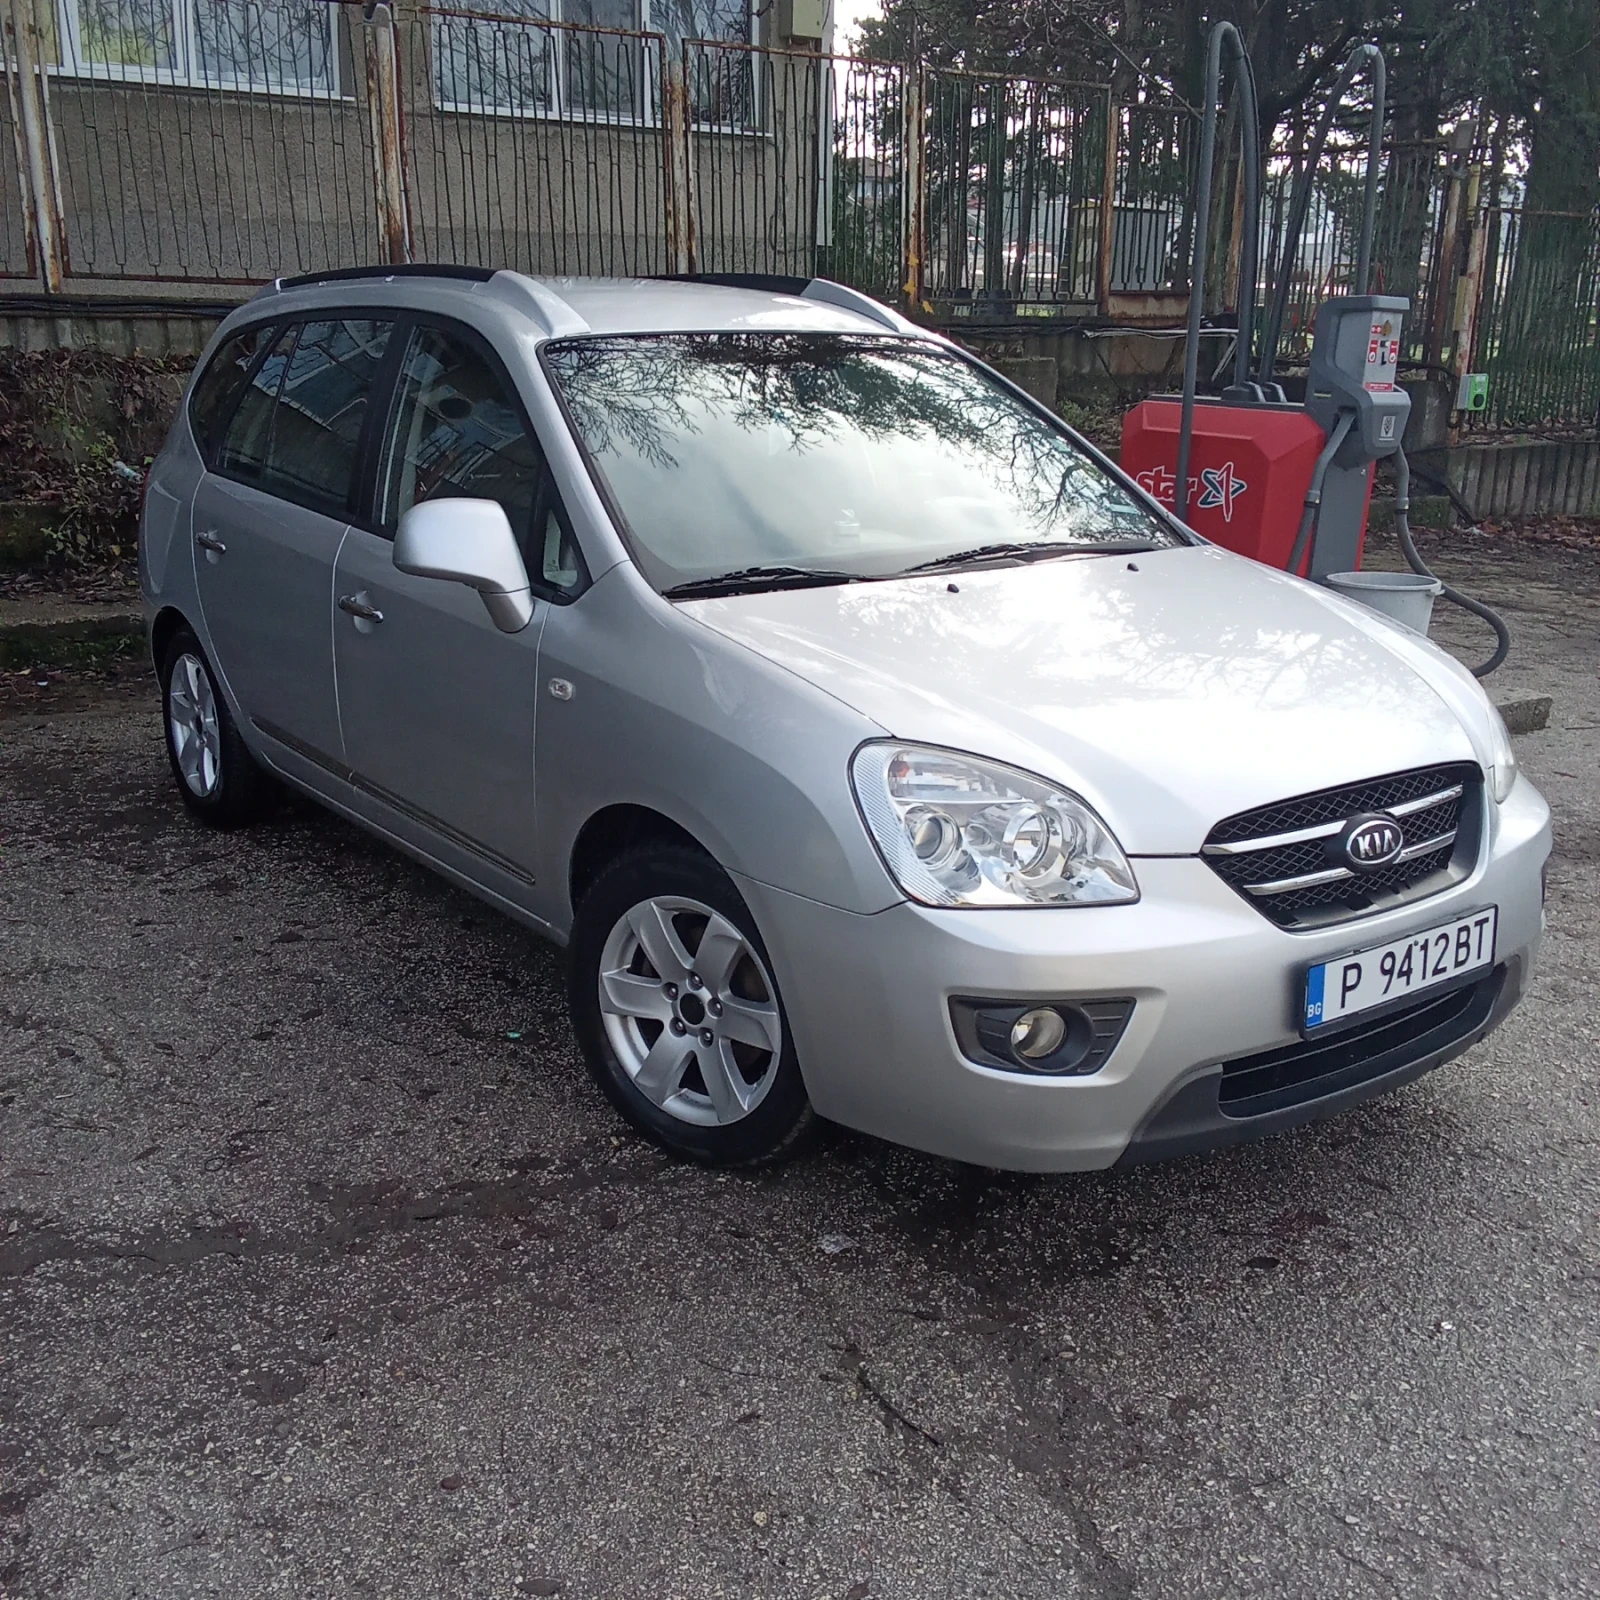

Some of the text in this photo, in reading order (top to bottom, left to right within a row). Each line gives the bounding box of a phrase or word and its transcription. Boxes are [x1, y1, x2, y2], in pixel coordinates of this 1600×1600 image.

[1356, 828, 1396, 859] KIA
[1340, 962, 1362, 1009] P
[1307, 1001, 1322, 1018] BG
